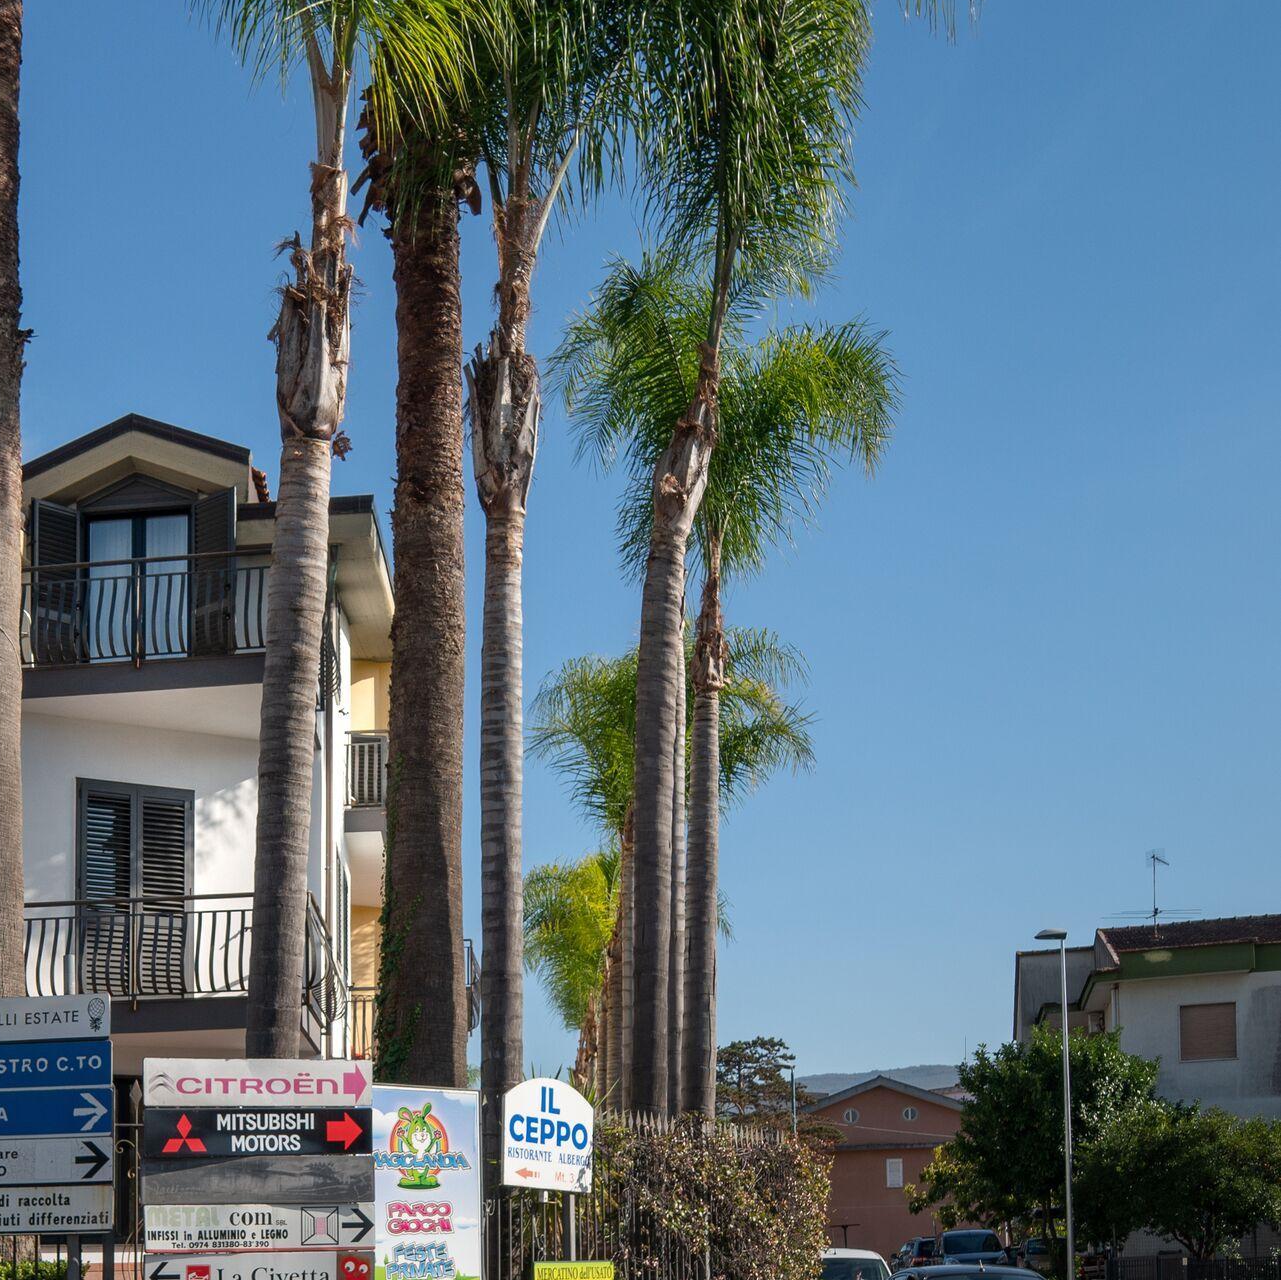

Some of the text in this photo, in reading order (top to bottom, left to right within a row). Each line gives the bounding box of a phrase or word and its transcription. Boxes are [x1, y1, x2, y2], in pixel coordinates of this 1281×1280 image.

[24, 1010, 79, 1025] ESTATE
[56, 1055, 102, 1072] C.TO
[541, 1086, 561, 1115] IL
[216, 1113, 315, 1131] MITSUBISHI
[509, 1114, 588, 1150] CEPPO
[231, 1134, 301, 1152] MOTORS
[507, 1147, 589, 1167] RISTORANTE ALBERGO
[18, 1193, 71, 1207] raccolta
[28, 1211, 109, 1226] differenziati
[229, 1211, 272, 1226] com
[386, 1201, 453, 1219] PARCO
[147, 1229, 288, 1241] INFISSI in ALLUMINIO e LEGNO
[386, 1218, 454, 1235] GIOCHI
[393, 1241, 448, 1263] FESTE
[386, 1260, 455, 1280] PRIVATE
[537, 1265, 612, 1280] MERCATINO dell'USATO
